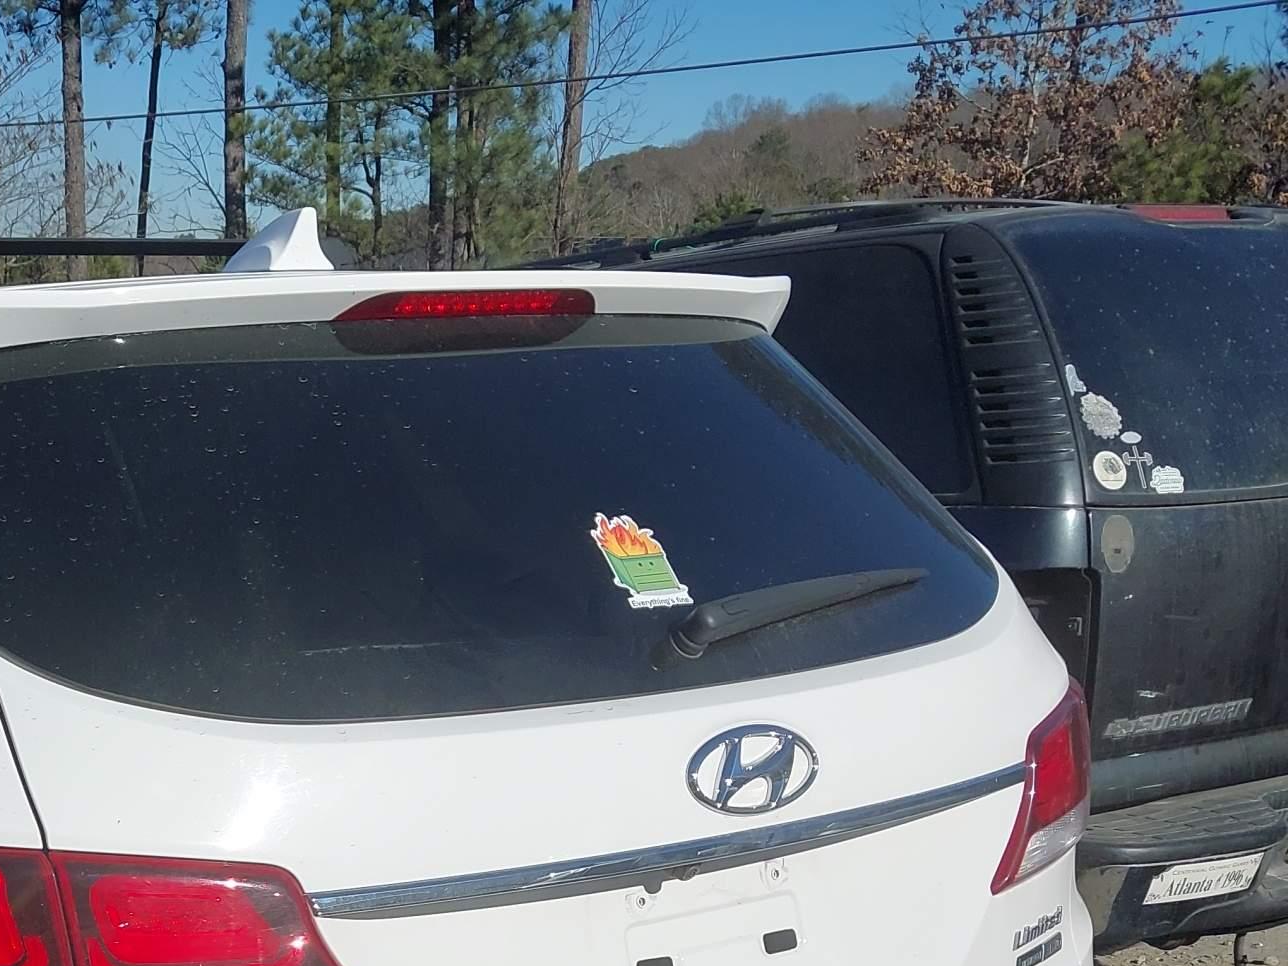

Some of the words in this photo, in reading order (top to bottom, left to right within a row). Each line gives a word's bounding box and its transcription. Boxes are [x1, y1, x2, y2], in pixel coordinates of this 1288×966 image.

[1164, 877, 1213, 897] Atlanta
[1221, 868, 1246, 889] 1996
[1013, 905, 1063, 951] Limited
